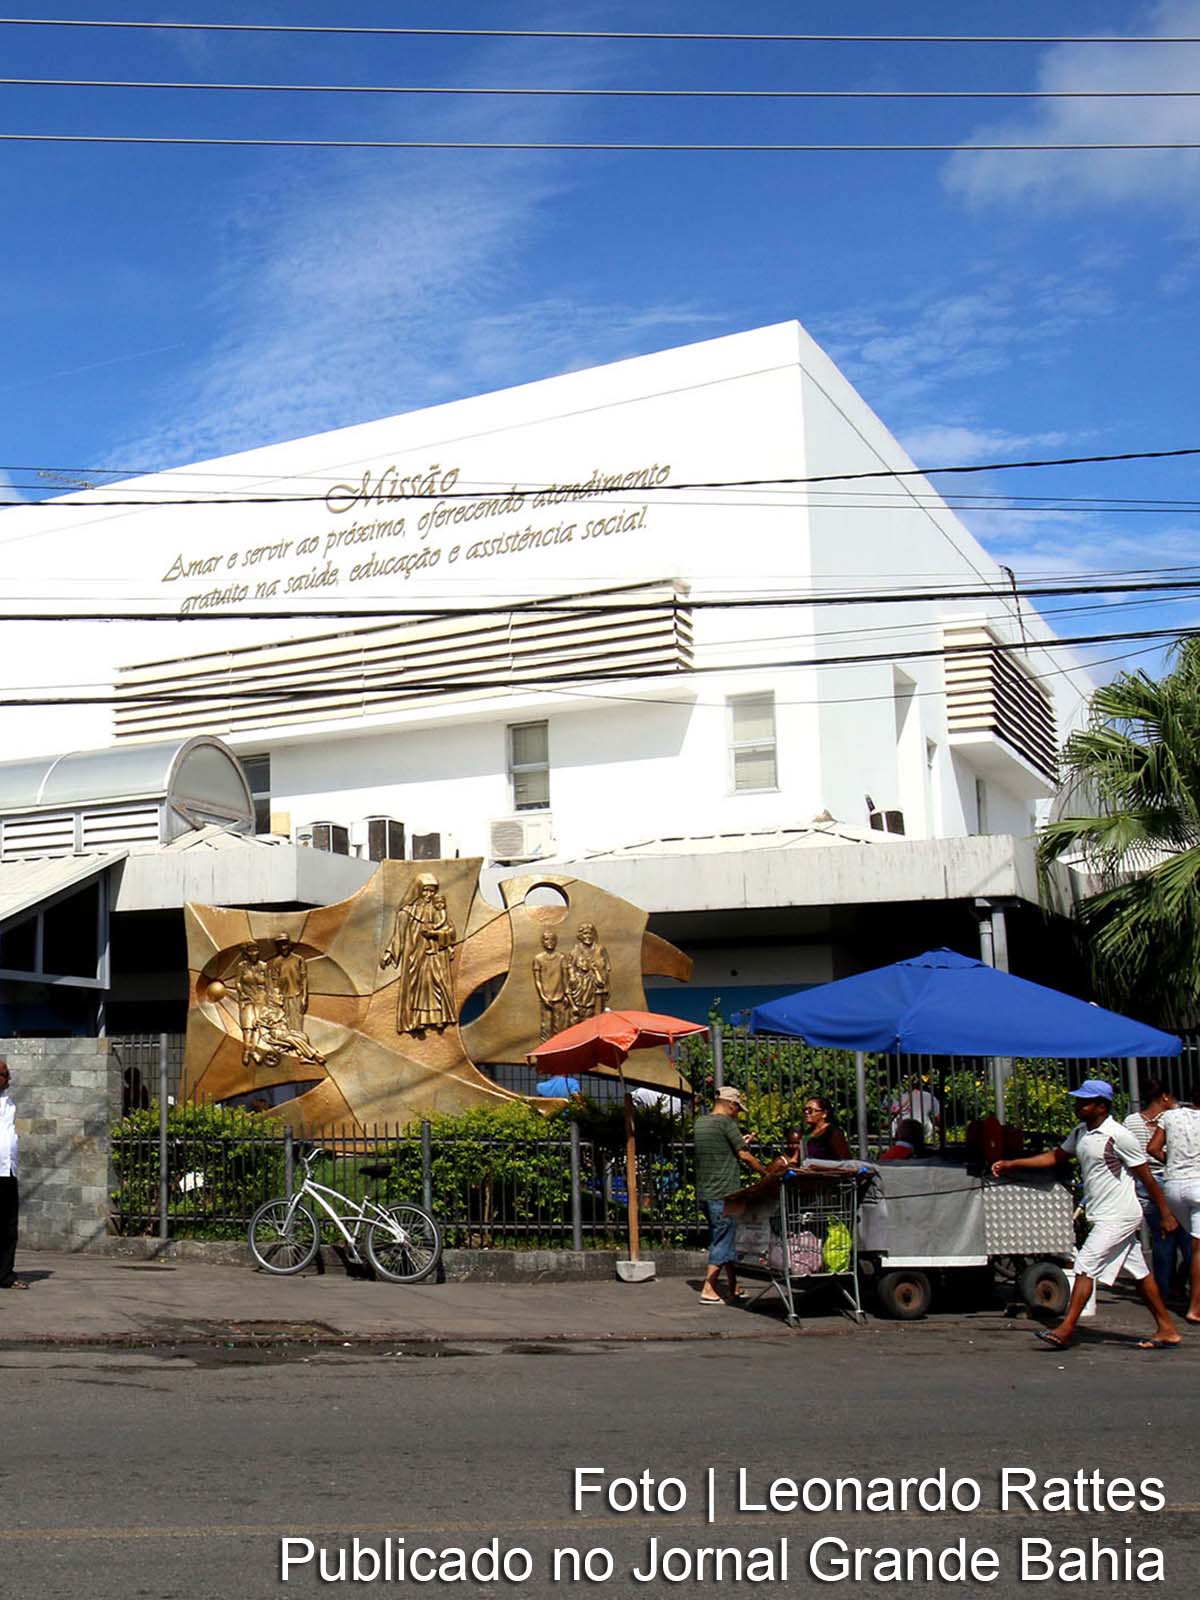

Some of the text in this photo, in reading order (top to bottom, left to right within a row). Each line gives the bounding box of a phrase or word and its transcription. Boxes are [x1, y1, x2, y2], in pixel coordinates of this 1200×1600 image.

[161, 463, 671, 582] Amar e servir ao próximo, oferecendo atendimento
[326, 464, 460, 514] Missão
[179, 583, 250, 619] gratuito
[254, 577, 281, 600] na
[349, 547, 442, 580] educação
[447, 544, 461, 564] e
[465, 521, 578, 561] assistência
[580, 504, 648, 541] social.
